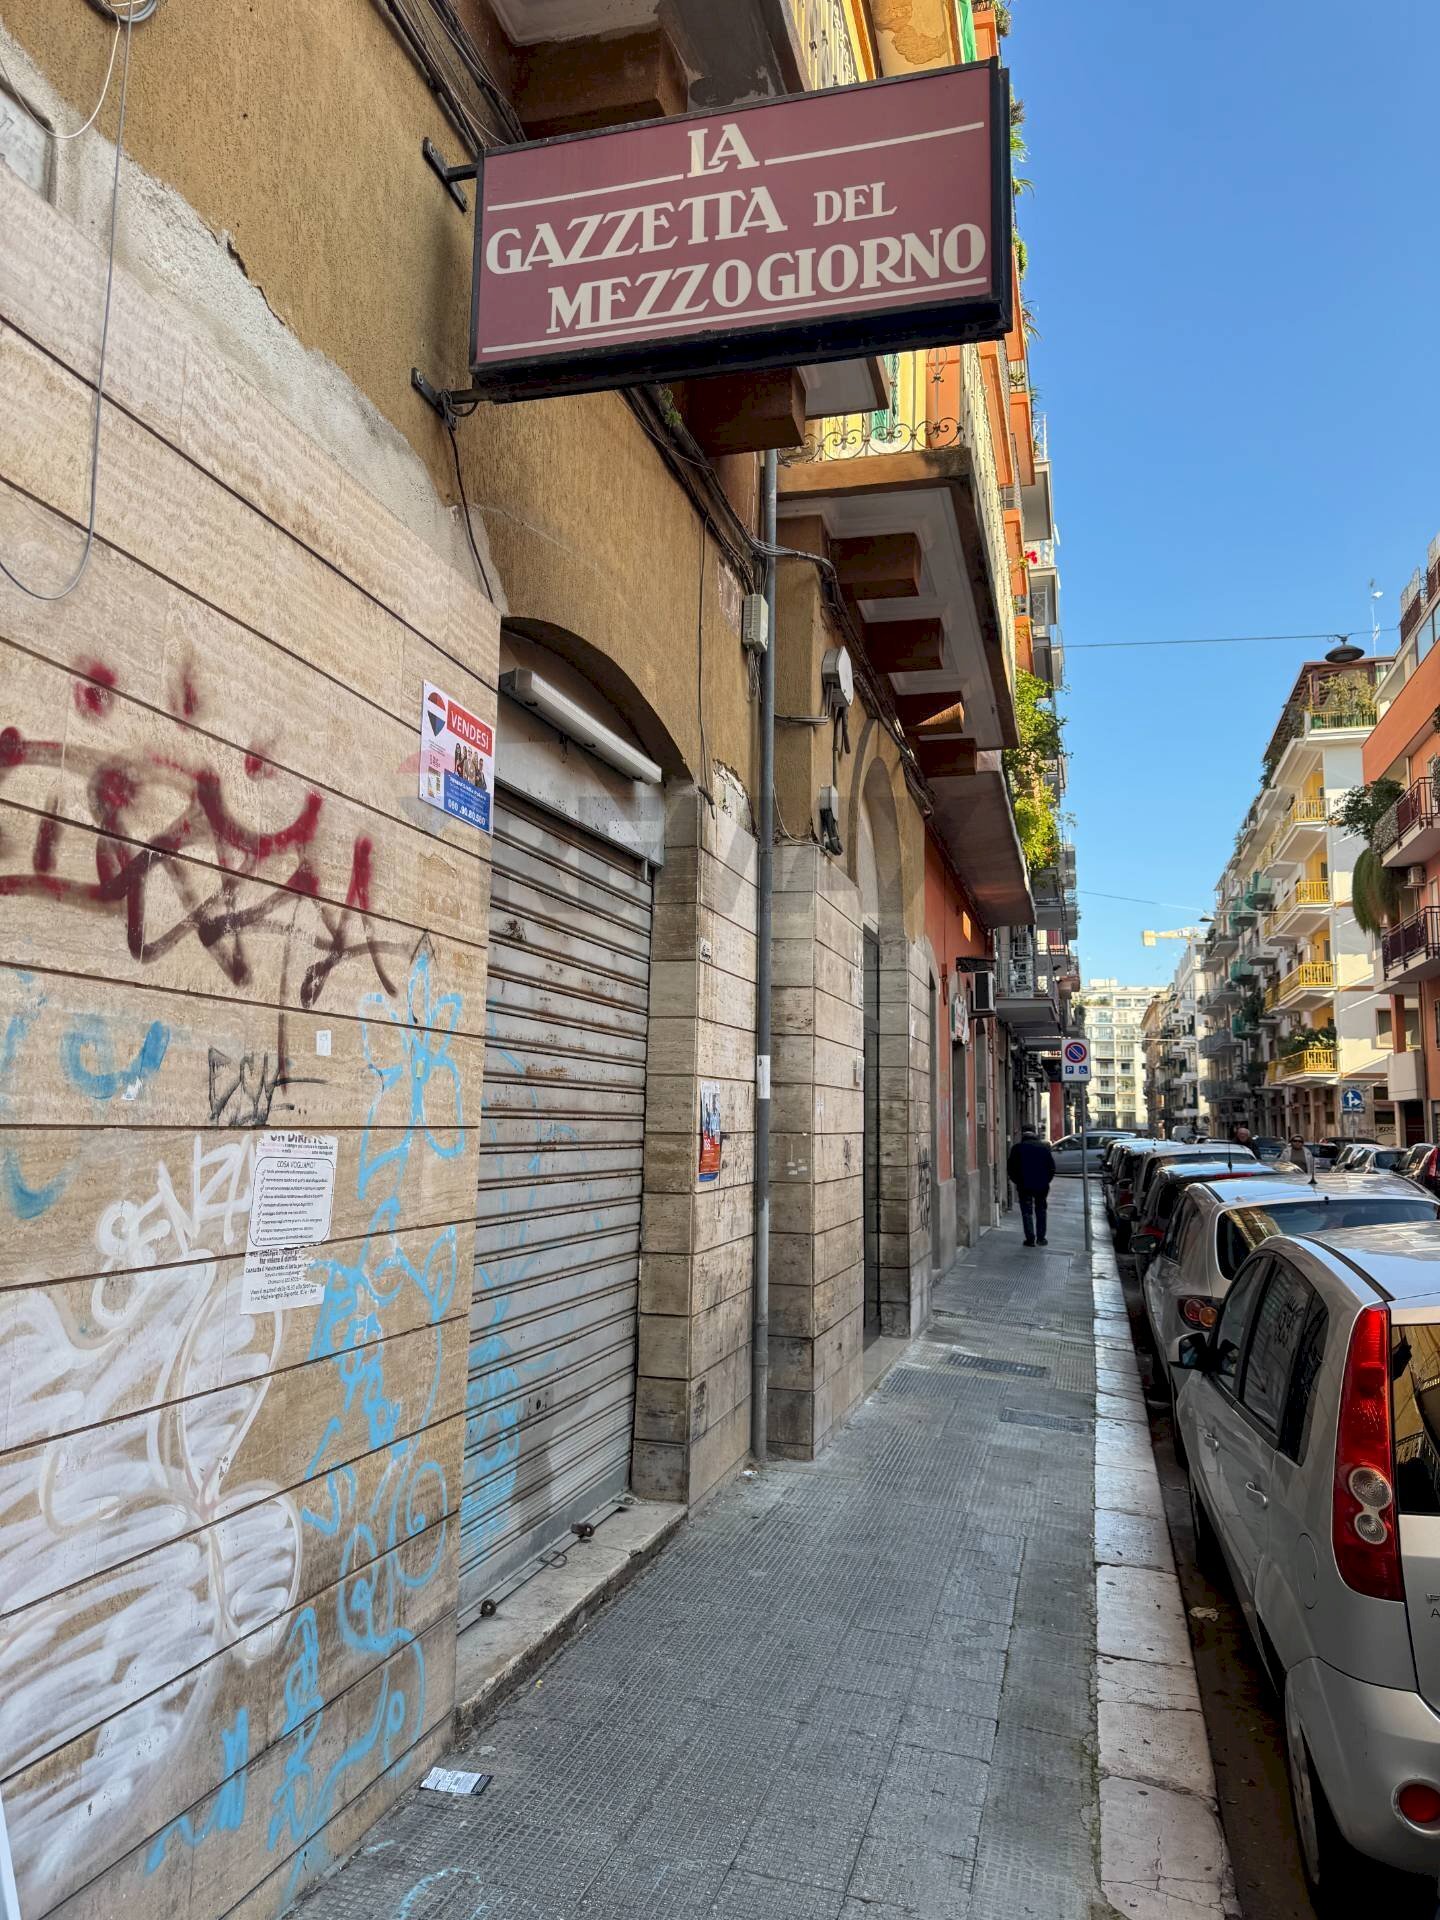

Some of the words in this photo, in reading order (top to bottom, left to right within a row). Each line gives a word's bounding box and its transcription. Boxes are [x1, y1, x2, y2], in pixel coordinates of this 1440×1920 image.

[686, 123, 760, 179] LA
[486, 186, 788, 275] GAZZETTA
[813, 181, 898, 227] DEL
[546, 224, 987, 335] MEZZOGIORNO
[451, 710, 489, 750] VENDESI
